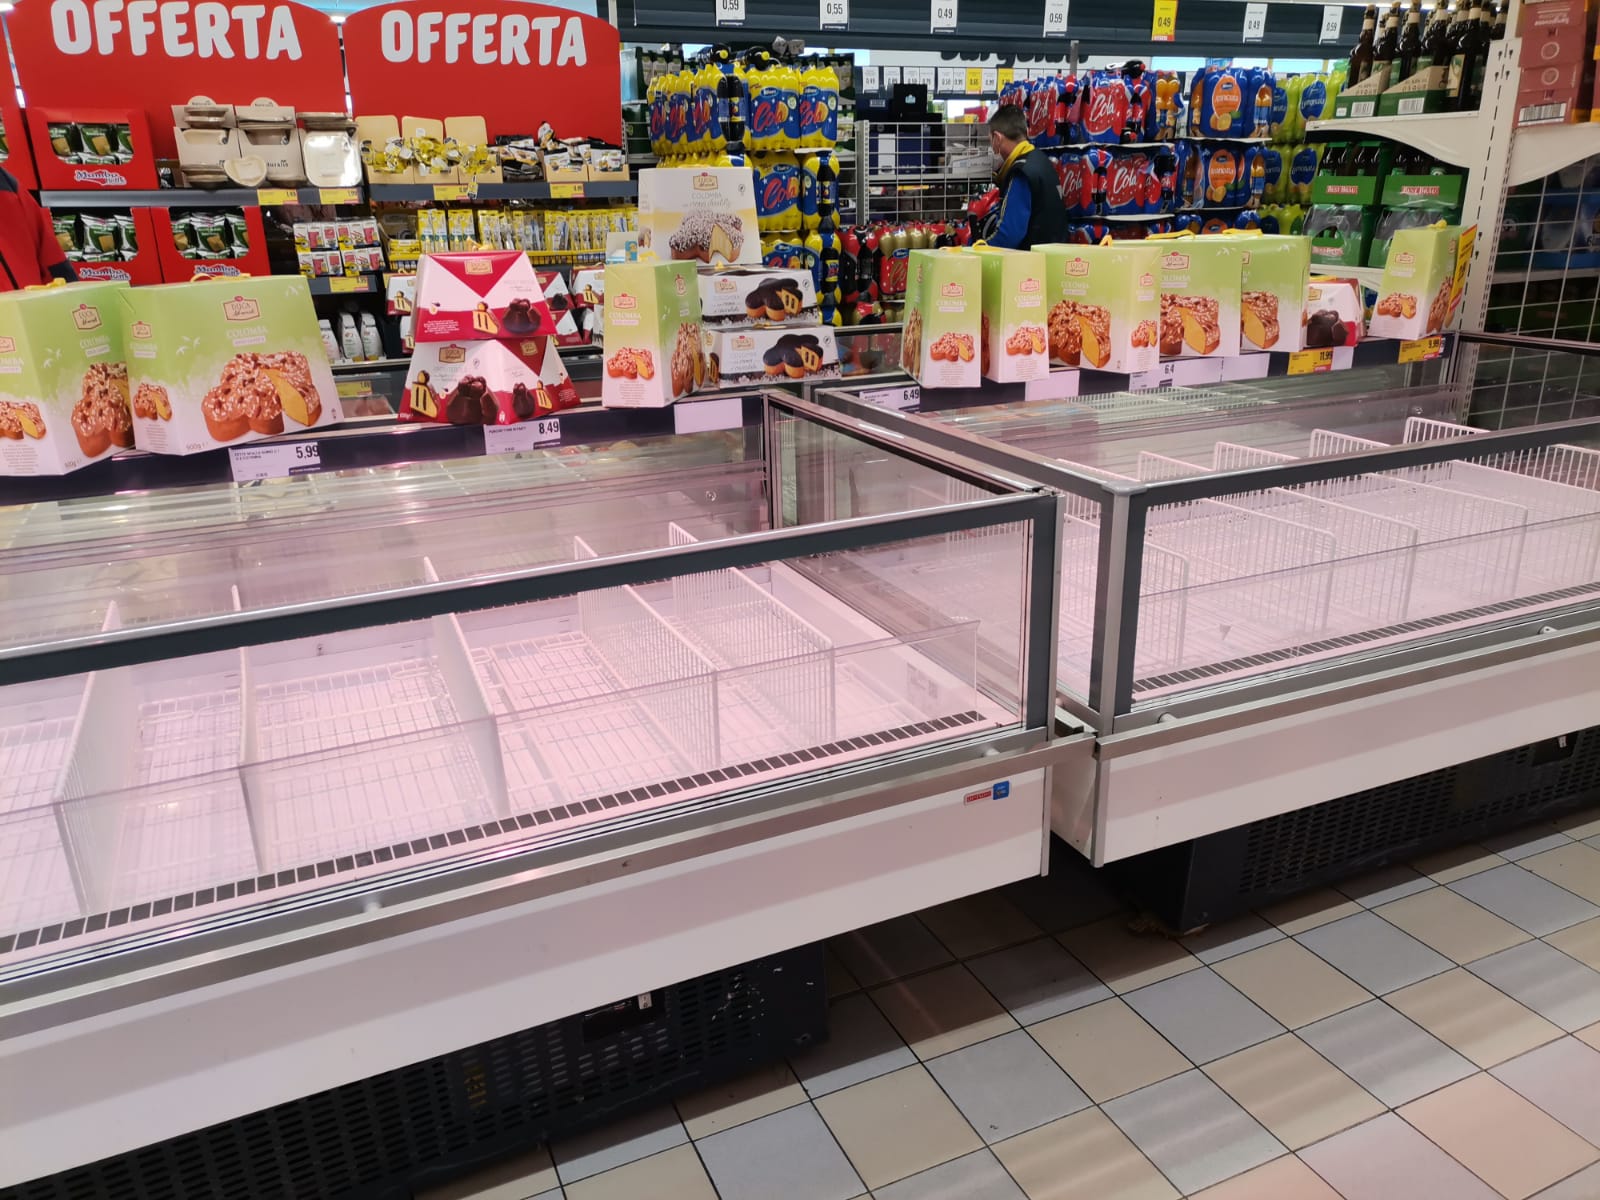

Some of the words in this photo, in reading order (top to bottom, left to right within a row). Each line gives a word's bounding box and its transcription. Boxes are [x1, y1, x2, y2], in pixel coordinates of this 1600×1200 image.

[51, 1, 302, 61] OFFERTA
[381, 10, 588, 67] OFFERTA
[1089, 94, 1116, 122] Cola
[1062, 170, 1083, 197] Cola
[1113, 167, 1138, 194] Cola
